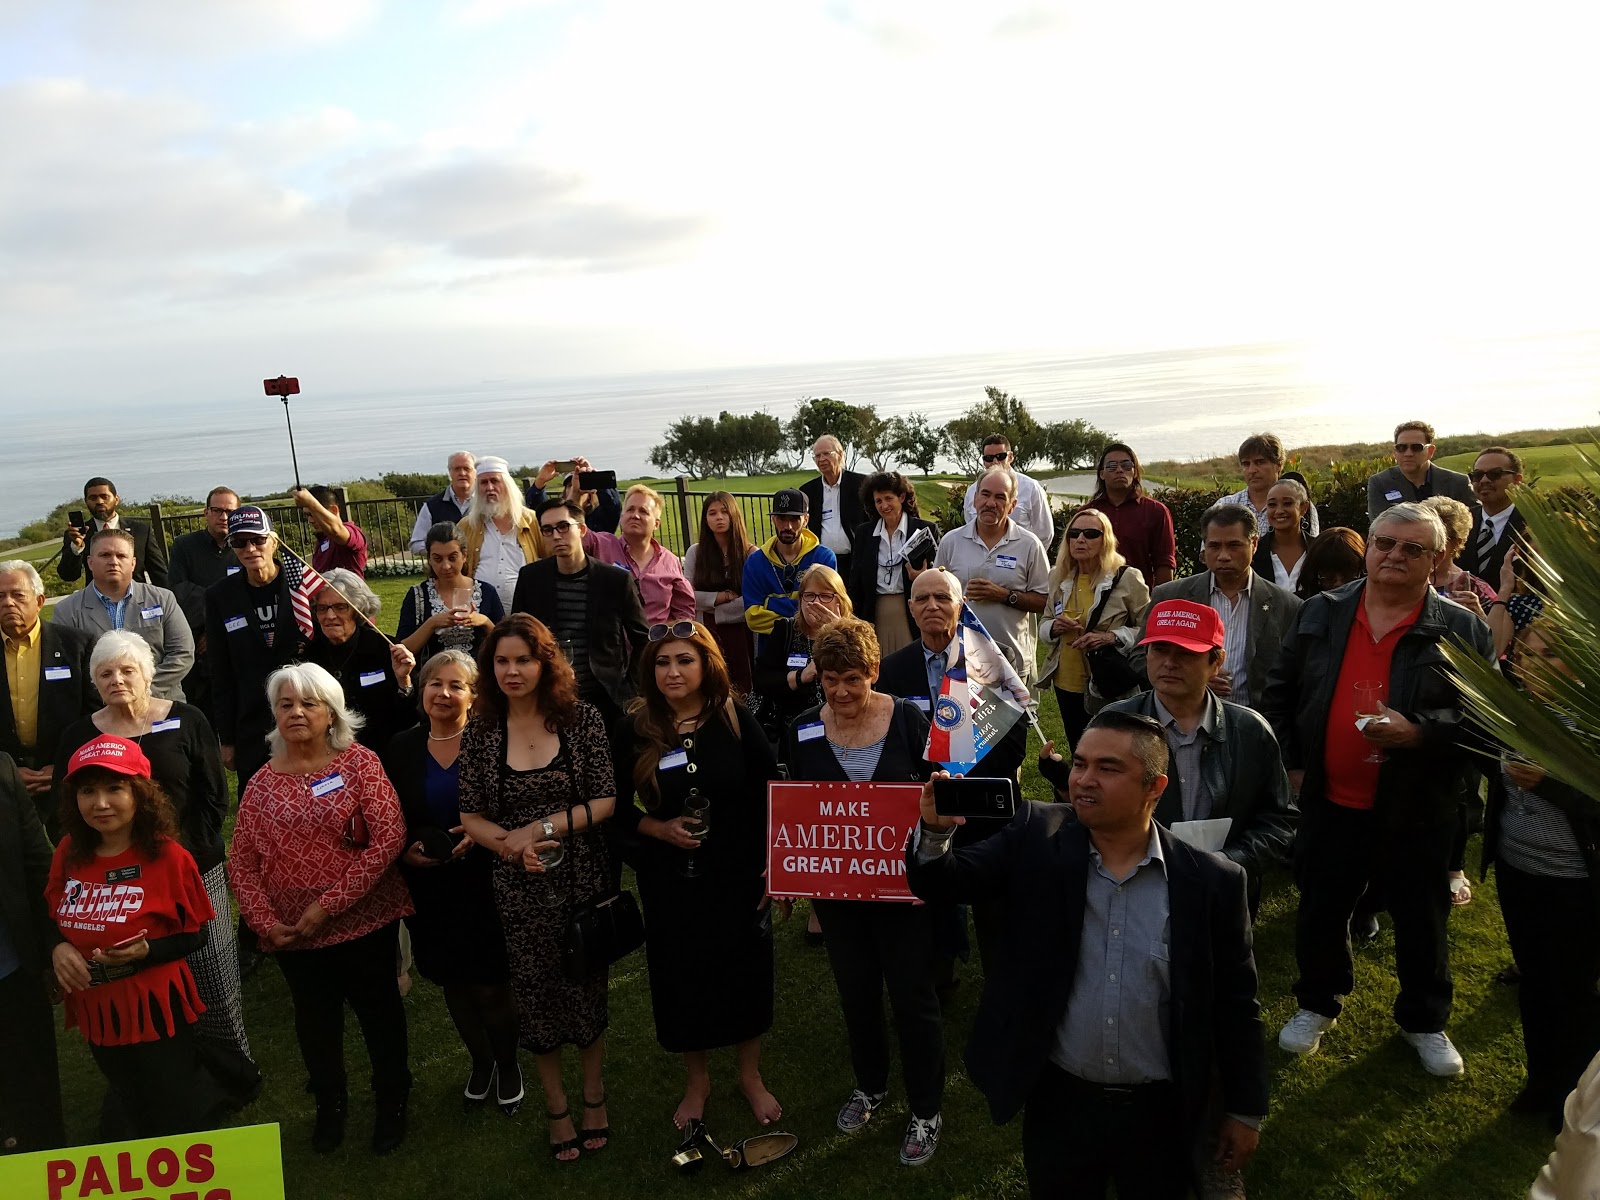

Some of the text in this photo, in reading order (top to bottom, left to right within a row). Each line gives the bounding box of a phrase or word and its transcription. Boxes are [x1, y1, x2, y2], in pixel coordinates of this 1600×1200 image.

[229, 513, 260, 521] TRUMP
[1172, 611, 1201, 621] AMERICA
[1176, 620, 1197, 629] AGAIN
[79, 742, 127, 756] MAKE AMERICA
[79, 749, 123, 761] GREAT AGAIN
[819, 801, 870, 817] MAKE
[783, 856, 907, 876] GREAT AGAIN
[60, 919, 106, 932] LOS ANGELES
[47, 1143, 215, 1200] PALOS
